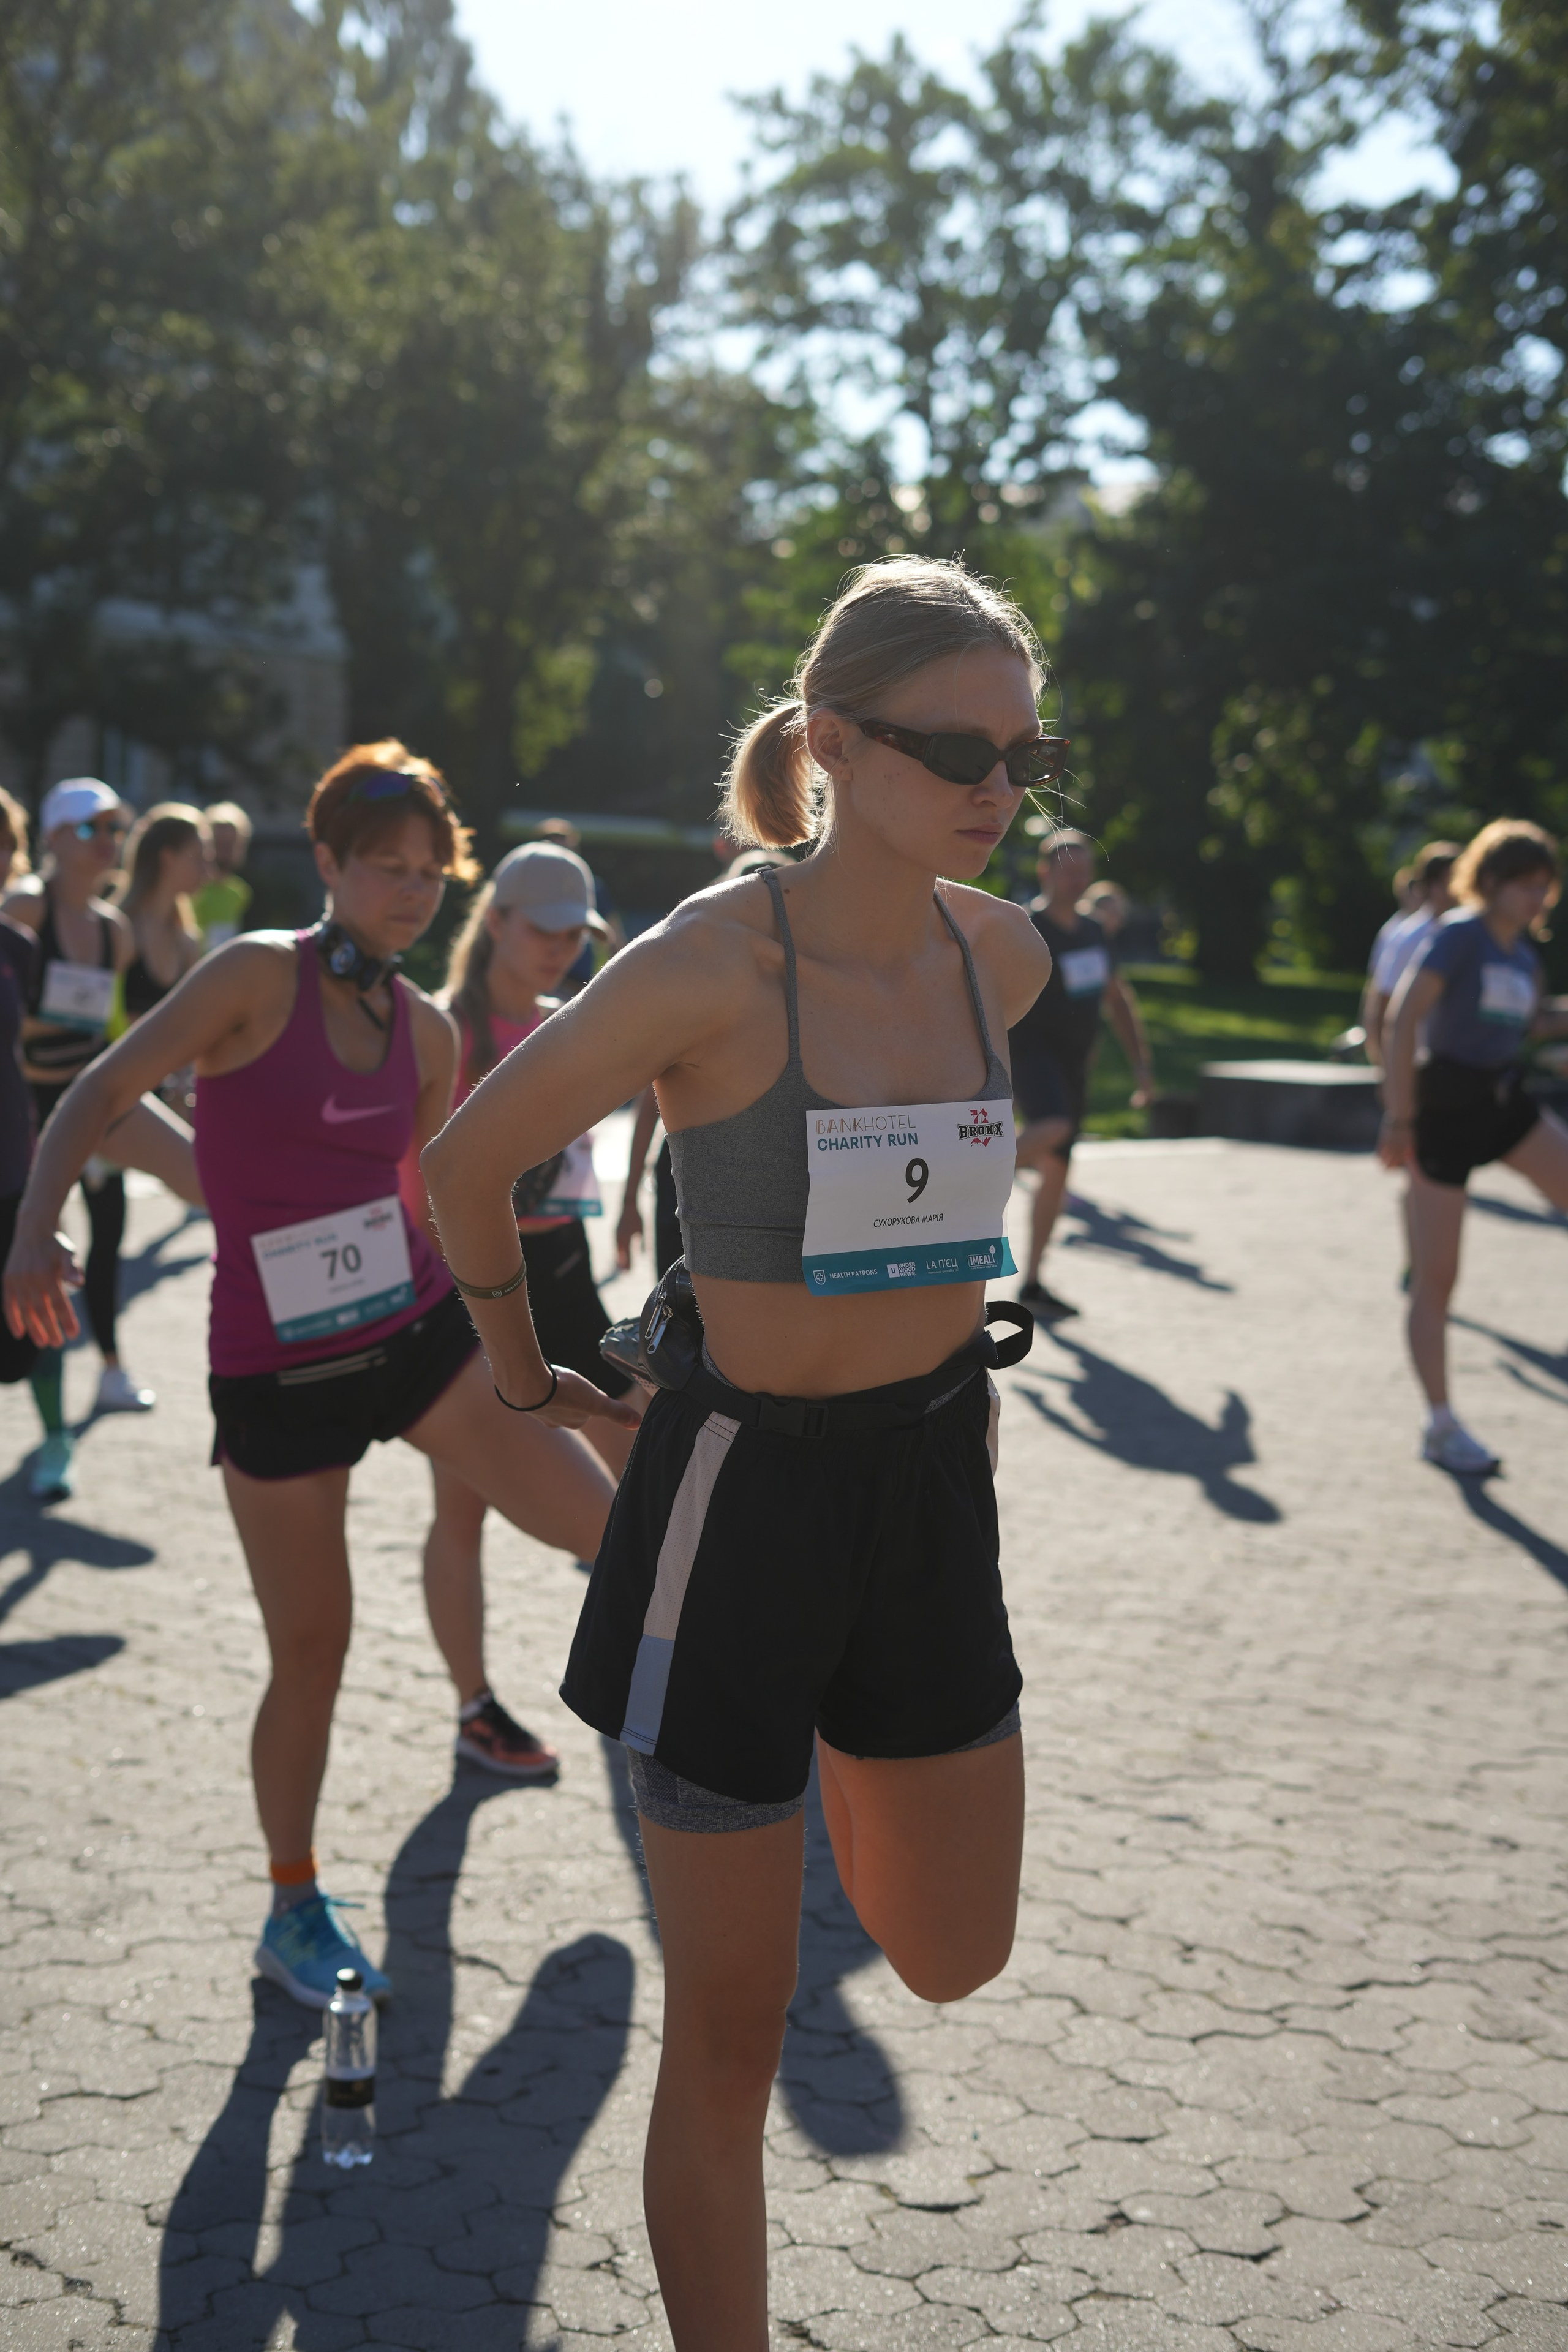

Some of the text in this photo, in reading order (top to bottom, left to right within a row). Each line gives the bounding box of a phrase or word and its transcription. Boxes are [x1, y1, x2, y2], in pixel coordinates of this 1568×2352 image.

[816, 1114, 916, 1134] BANKHOTEL
[957, 1121, 1004, 1140] BRONX
[817, 1133, 919, 1152] CHARITY RUN
[905, 1158, 929, 1204] 9
[873, 1213, 944, 1227] СУХОРУКОВА МАРІЯ
[320, 1243, 361, 1280] 70
[505, 1282, 519, 1293] HEALTH
